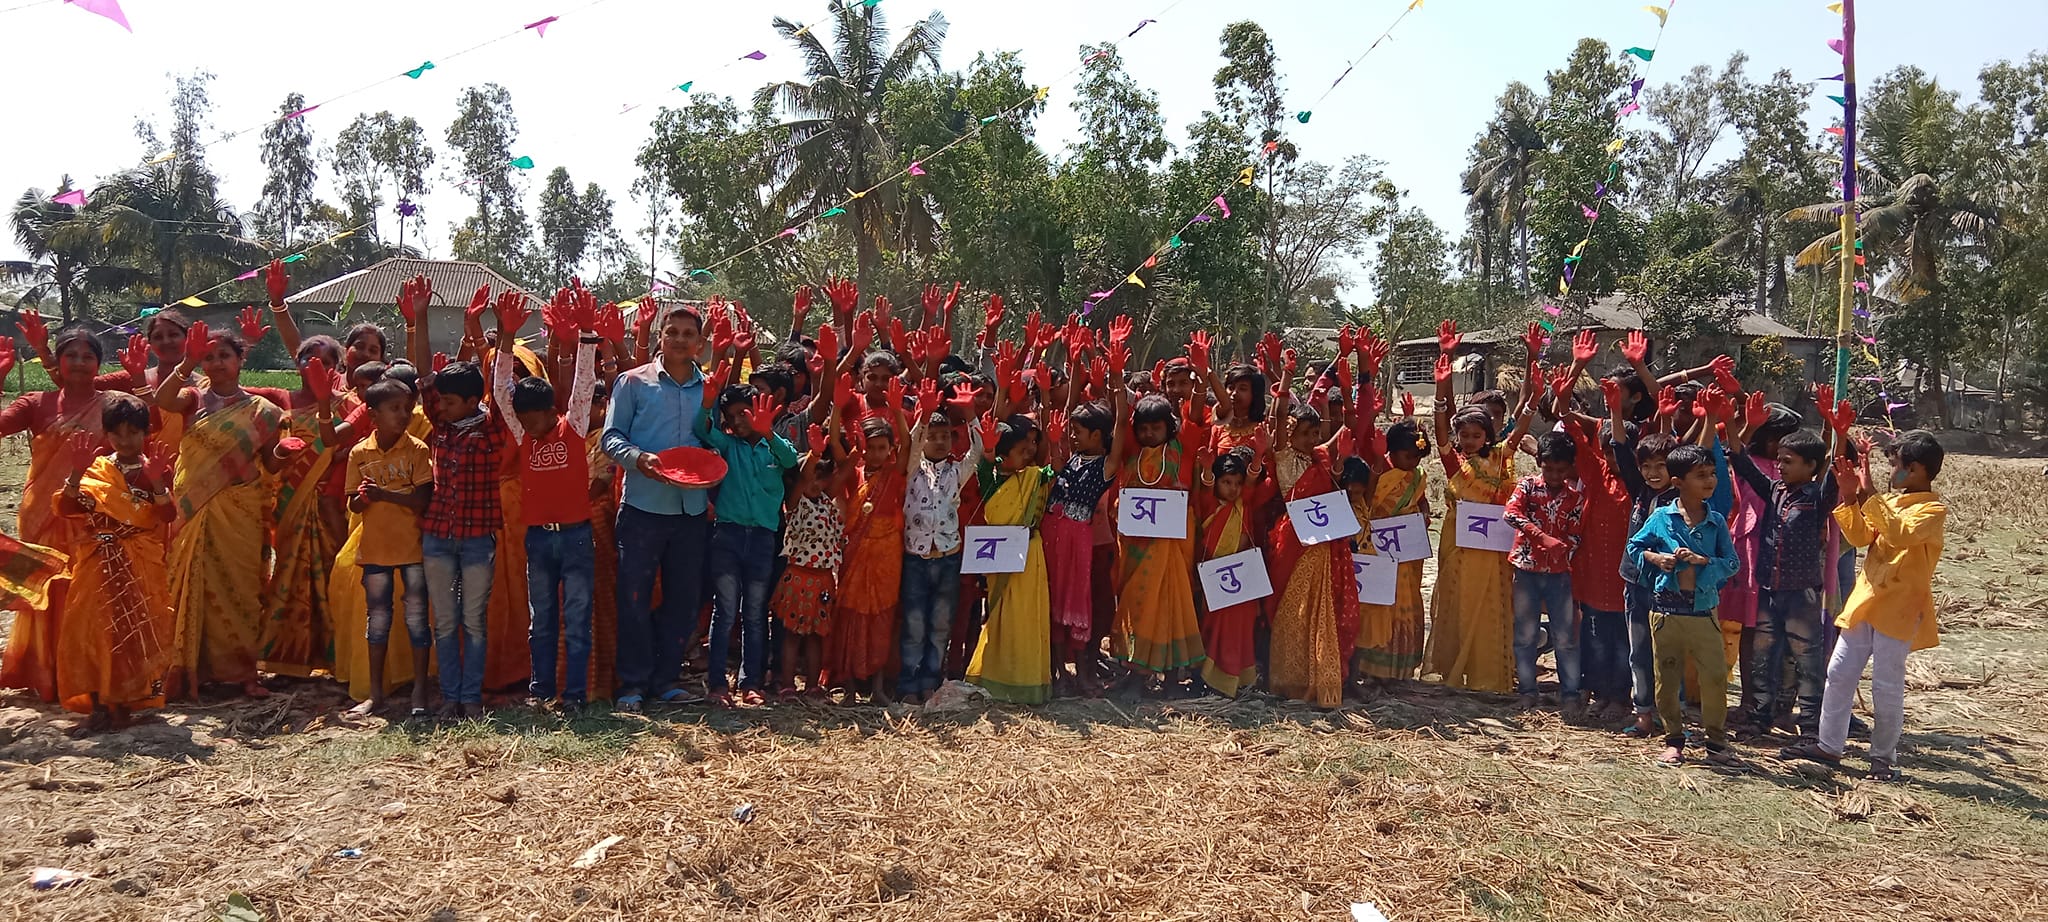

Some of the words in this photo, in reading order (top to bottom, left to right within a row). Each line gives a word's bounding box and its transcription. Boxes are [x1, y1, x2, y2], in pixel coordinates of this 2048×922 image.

[1131, 496, 1167, 525] স
[1303, 499, 1329, 527] উ
[1371, 524, 1407, 552] স
[1467, 515, 1499, 538] ব
[973, 537, 1008, 561] ব
